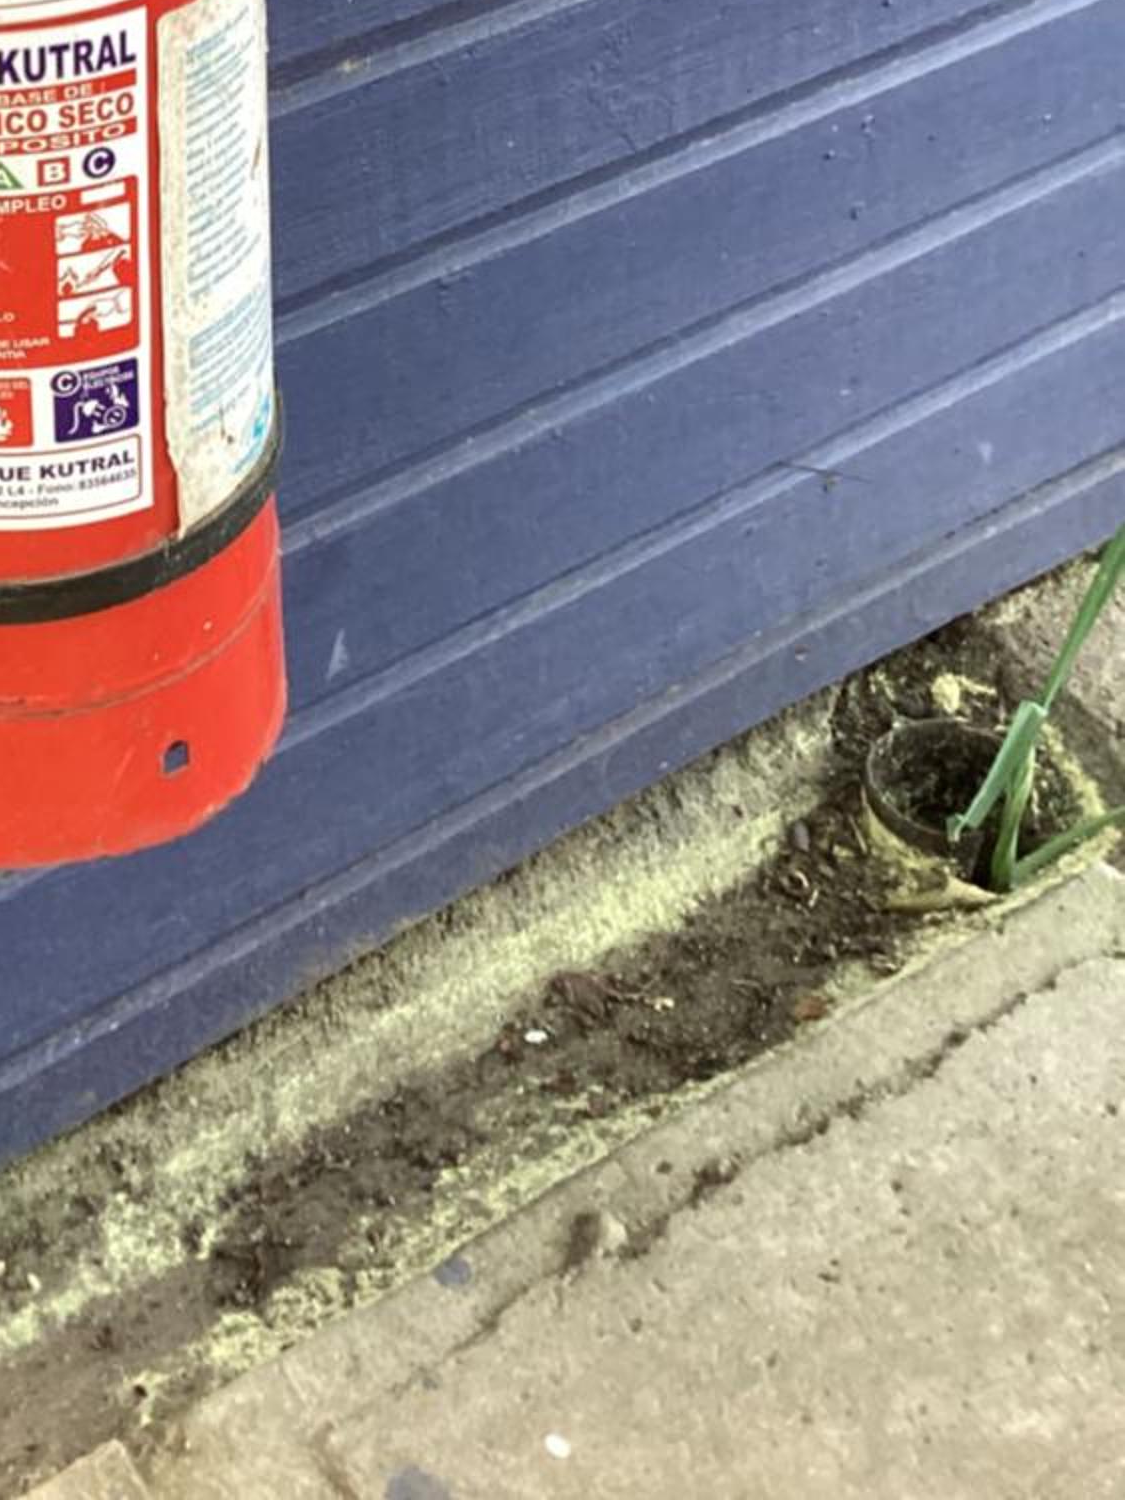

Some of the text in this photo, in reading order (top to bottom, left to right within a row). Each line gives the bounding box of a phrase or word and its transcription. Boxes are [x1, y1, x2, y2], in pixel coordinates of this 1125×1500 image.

[58, 91, 134, 130] SECO
[85, 149, 112, 177] C
[55, 372, 75, 393] C
[39, 449, 135, 480] KUTRAL
